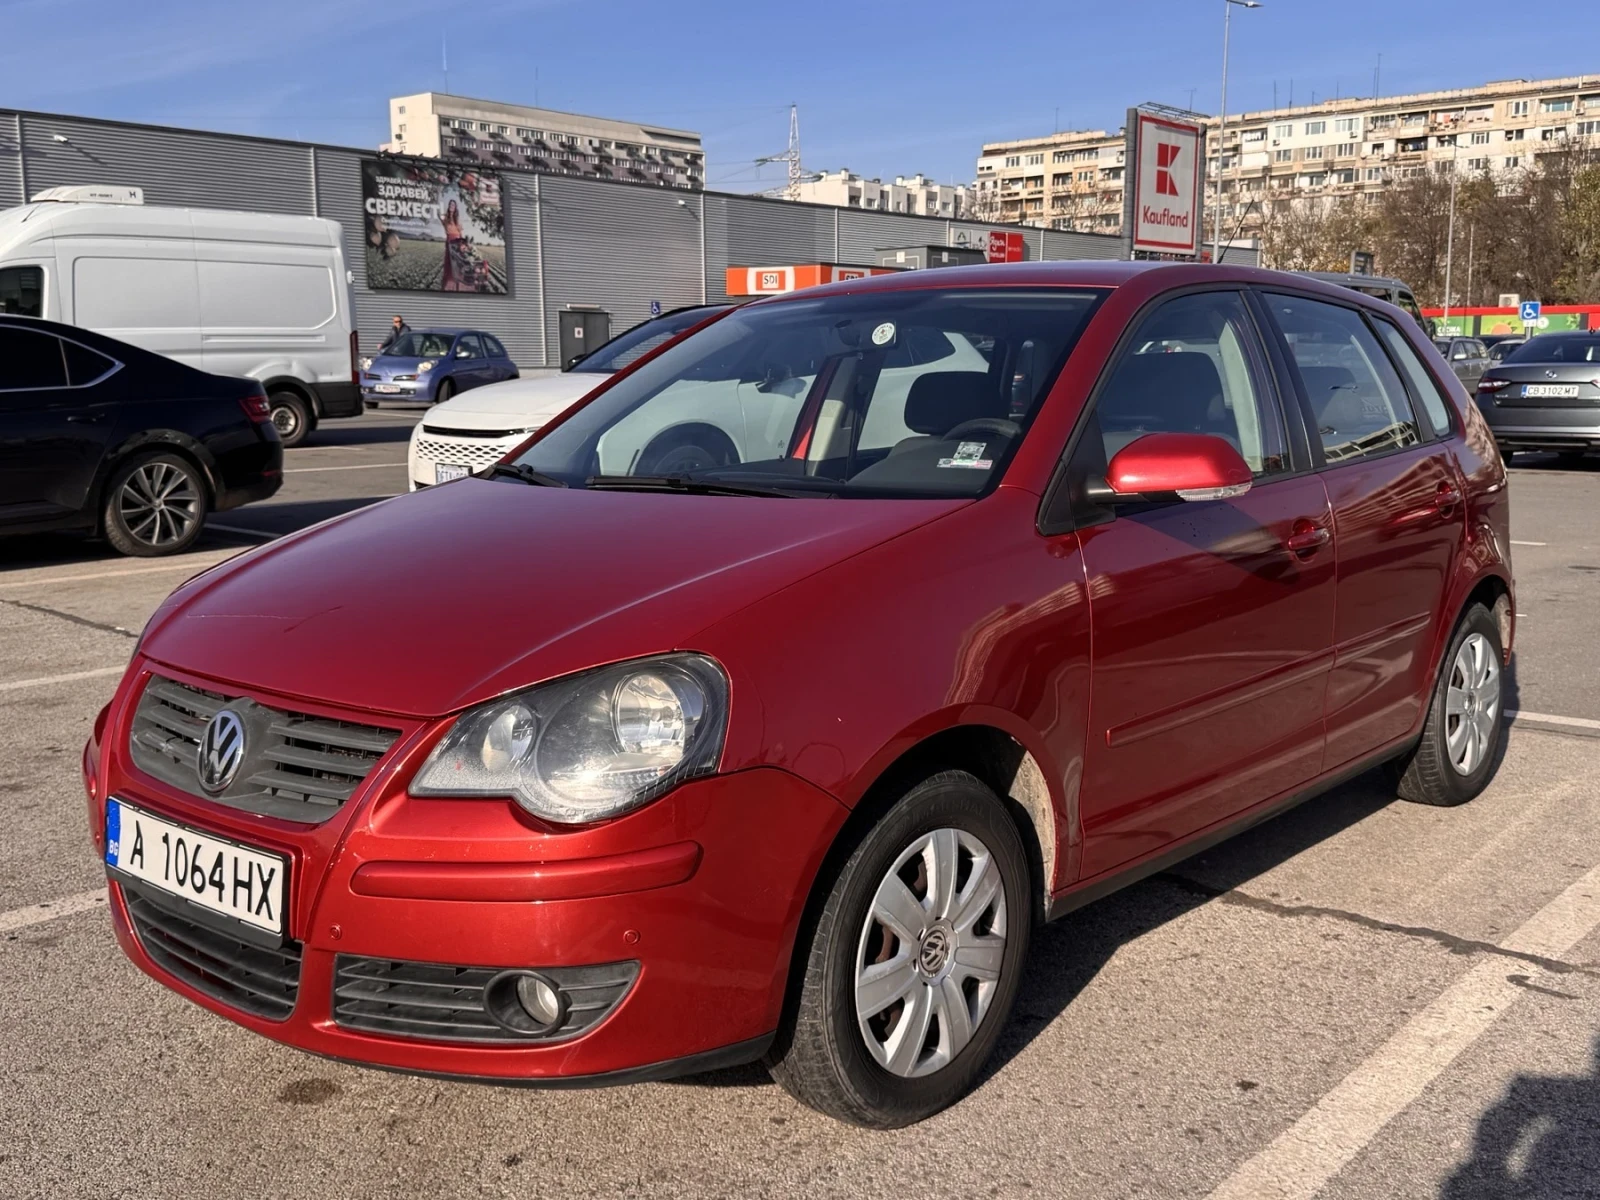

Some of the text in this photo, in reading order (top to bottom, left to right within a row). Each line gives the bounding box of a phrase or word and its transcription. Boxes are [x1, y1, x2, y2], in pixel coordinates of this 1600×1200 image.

[378, 184, 431, 202] ЗДРАВЕЙ,
[1143, 205, 1189, 228] Kaufland
[763, 274, 778, 285] SDI
[1527, 386, 1577, 395] CB 3102 MT
[108, 838, 120, 856] BG
[130, 819, 144, 870] A
